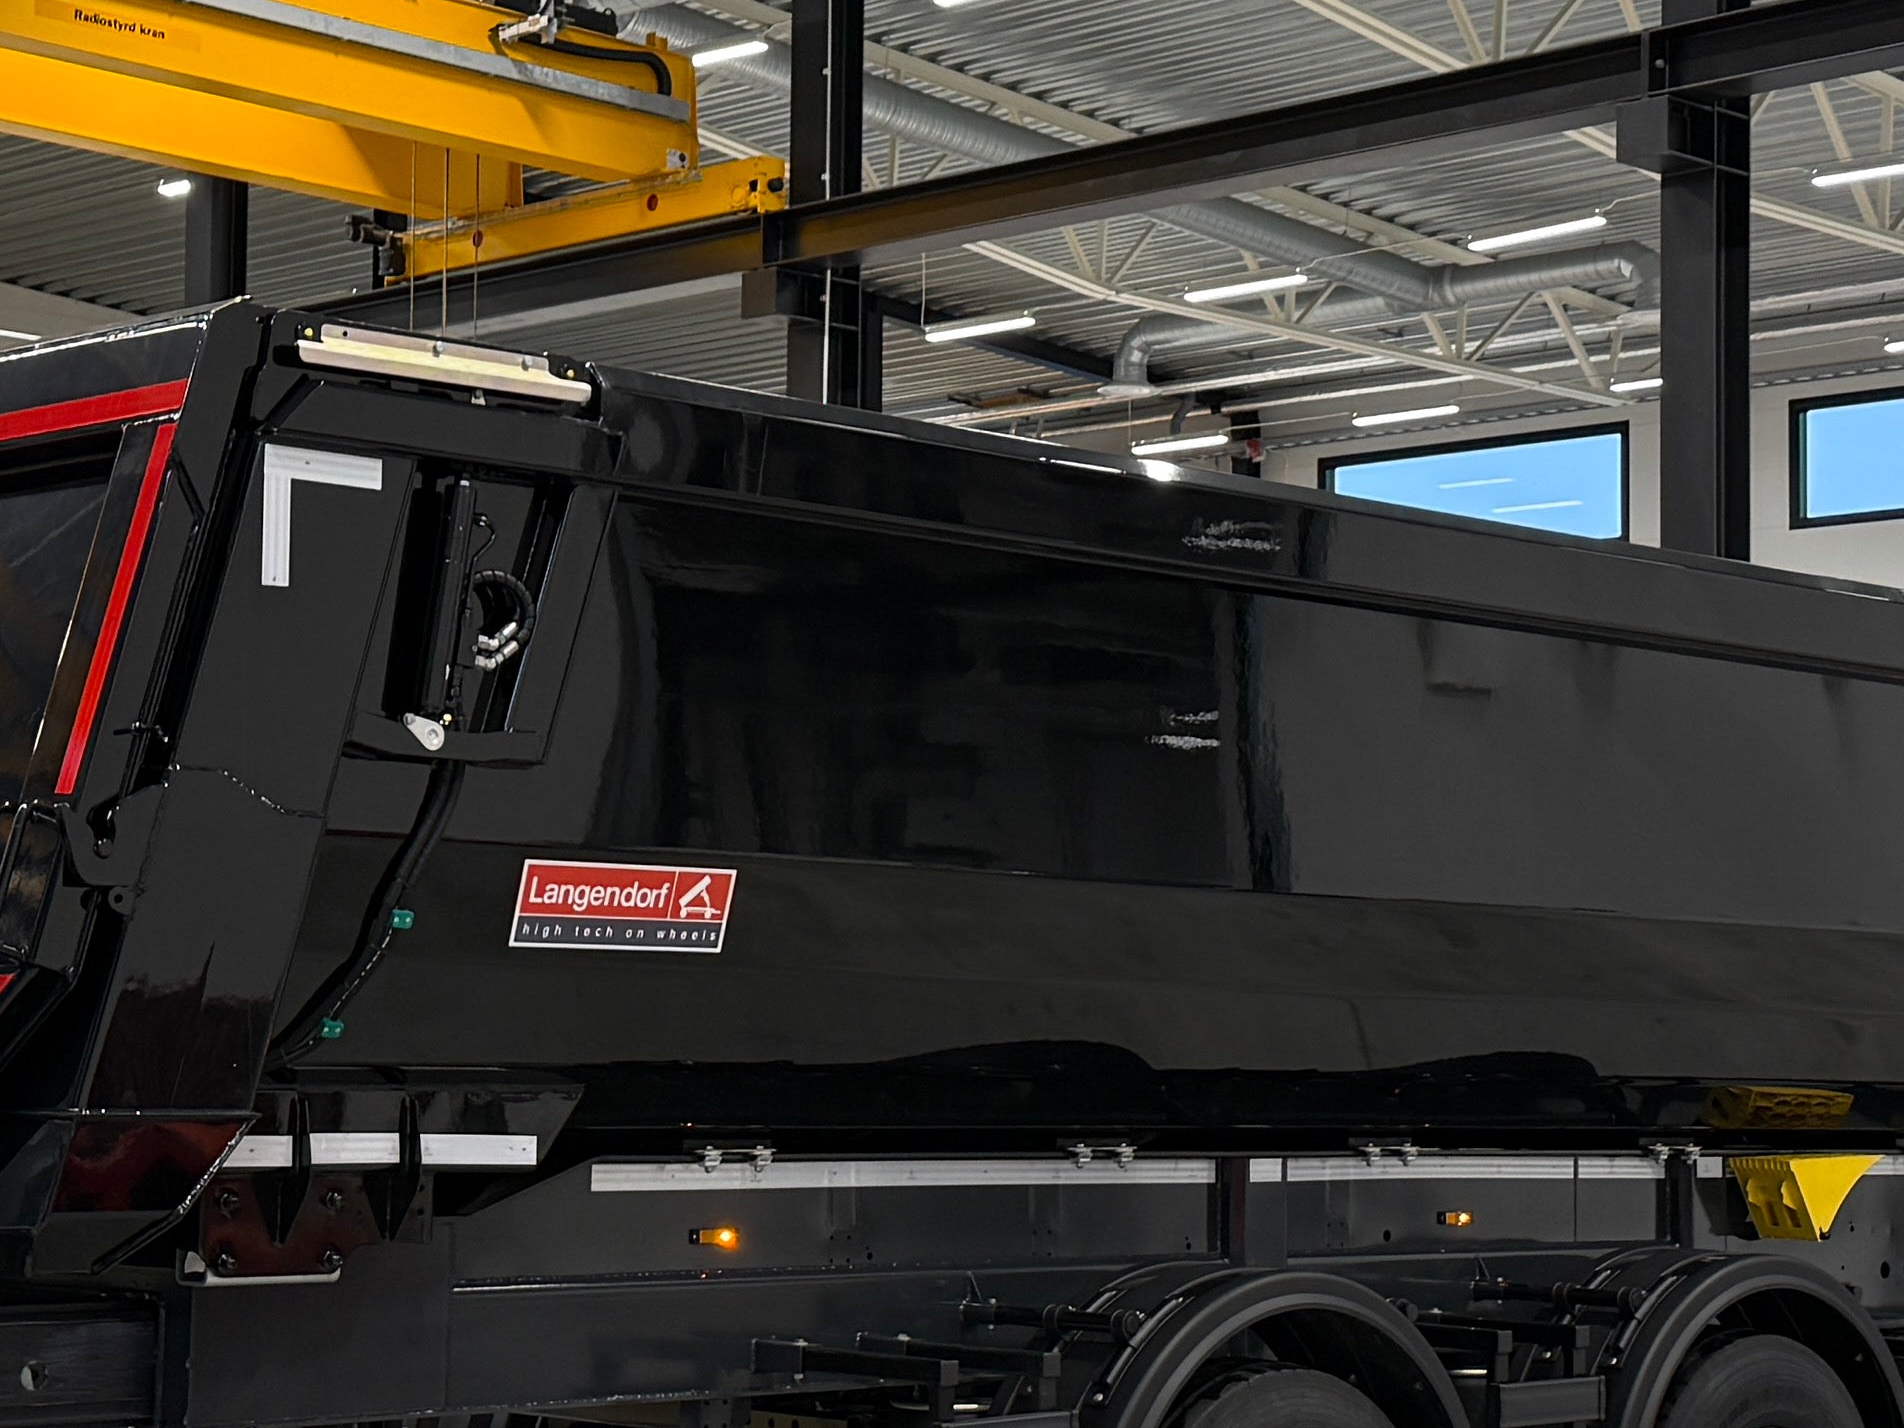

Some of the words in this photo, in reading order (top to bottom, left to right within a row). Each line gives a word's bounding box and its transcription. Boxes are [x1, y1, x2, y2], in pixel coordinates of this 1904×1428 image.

[74, 8, 136, 32] Radiostyrd
[140, 23, 165, 40] kran
[529, 875, 671, 911] Langendorf
[522, 923, 562, 938] high
[575, 925, 614, 938] tech
[625, 928, 645, 939] on
[656, 928, 718, 942] wheels
